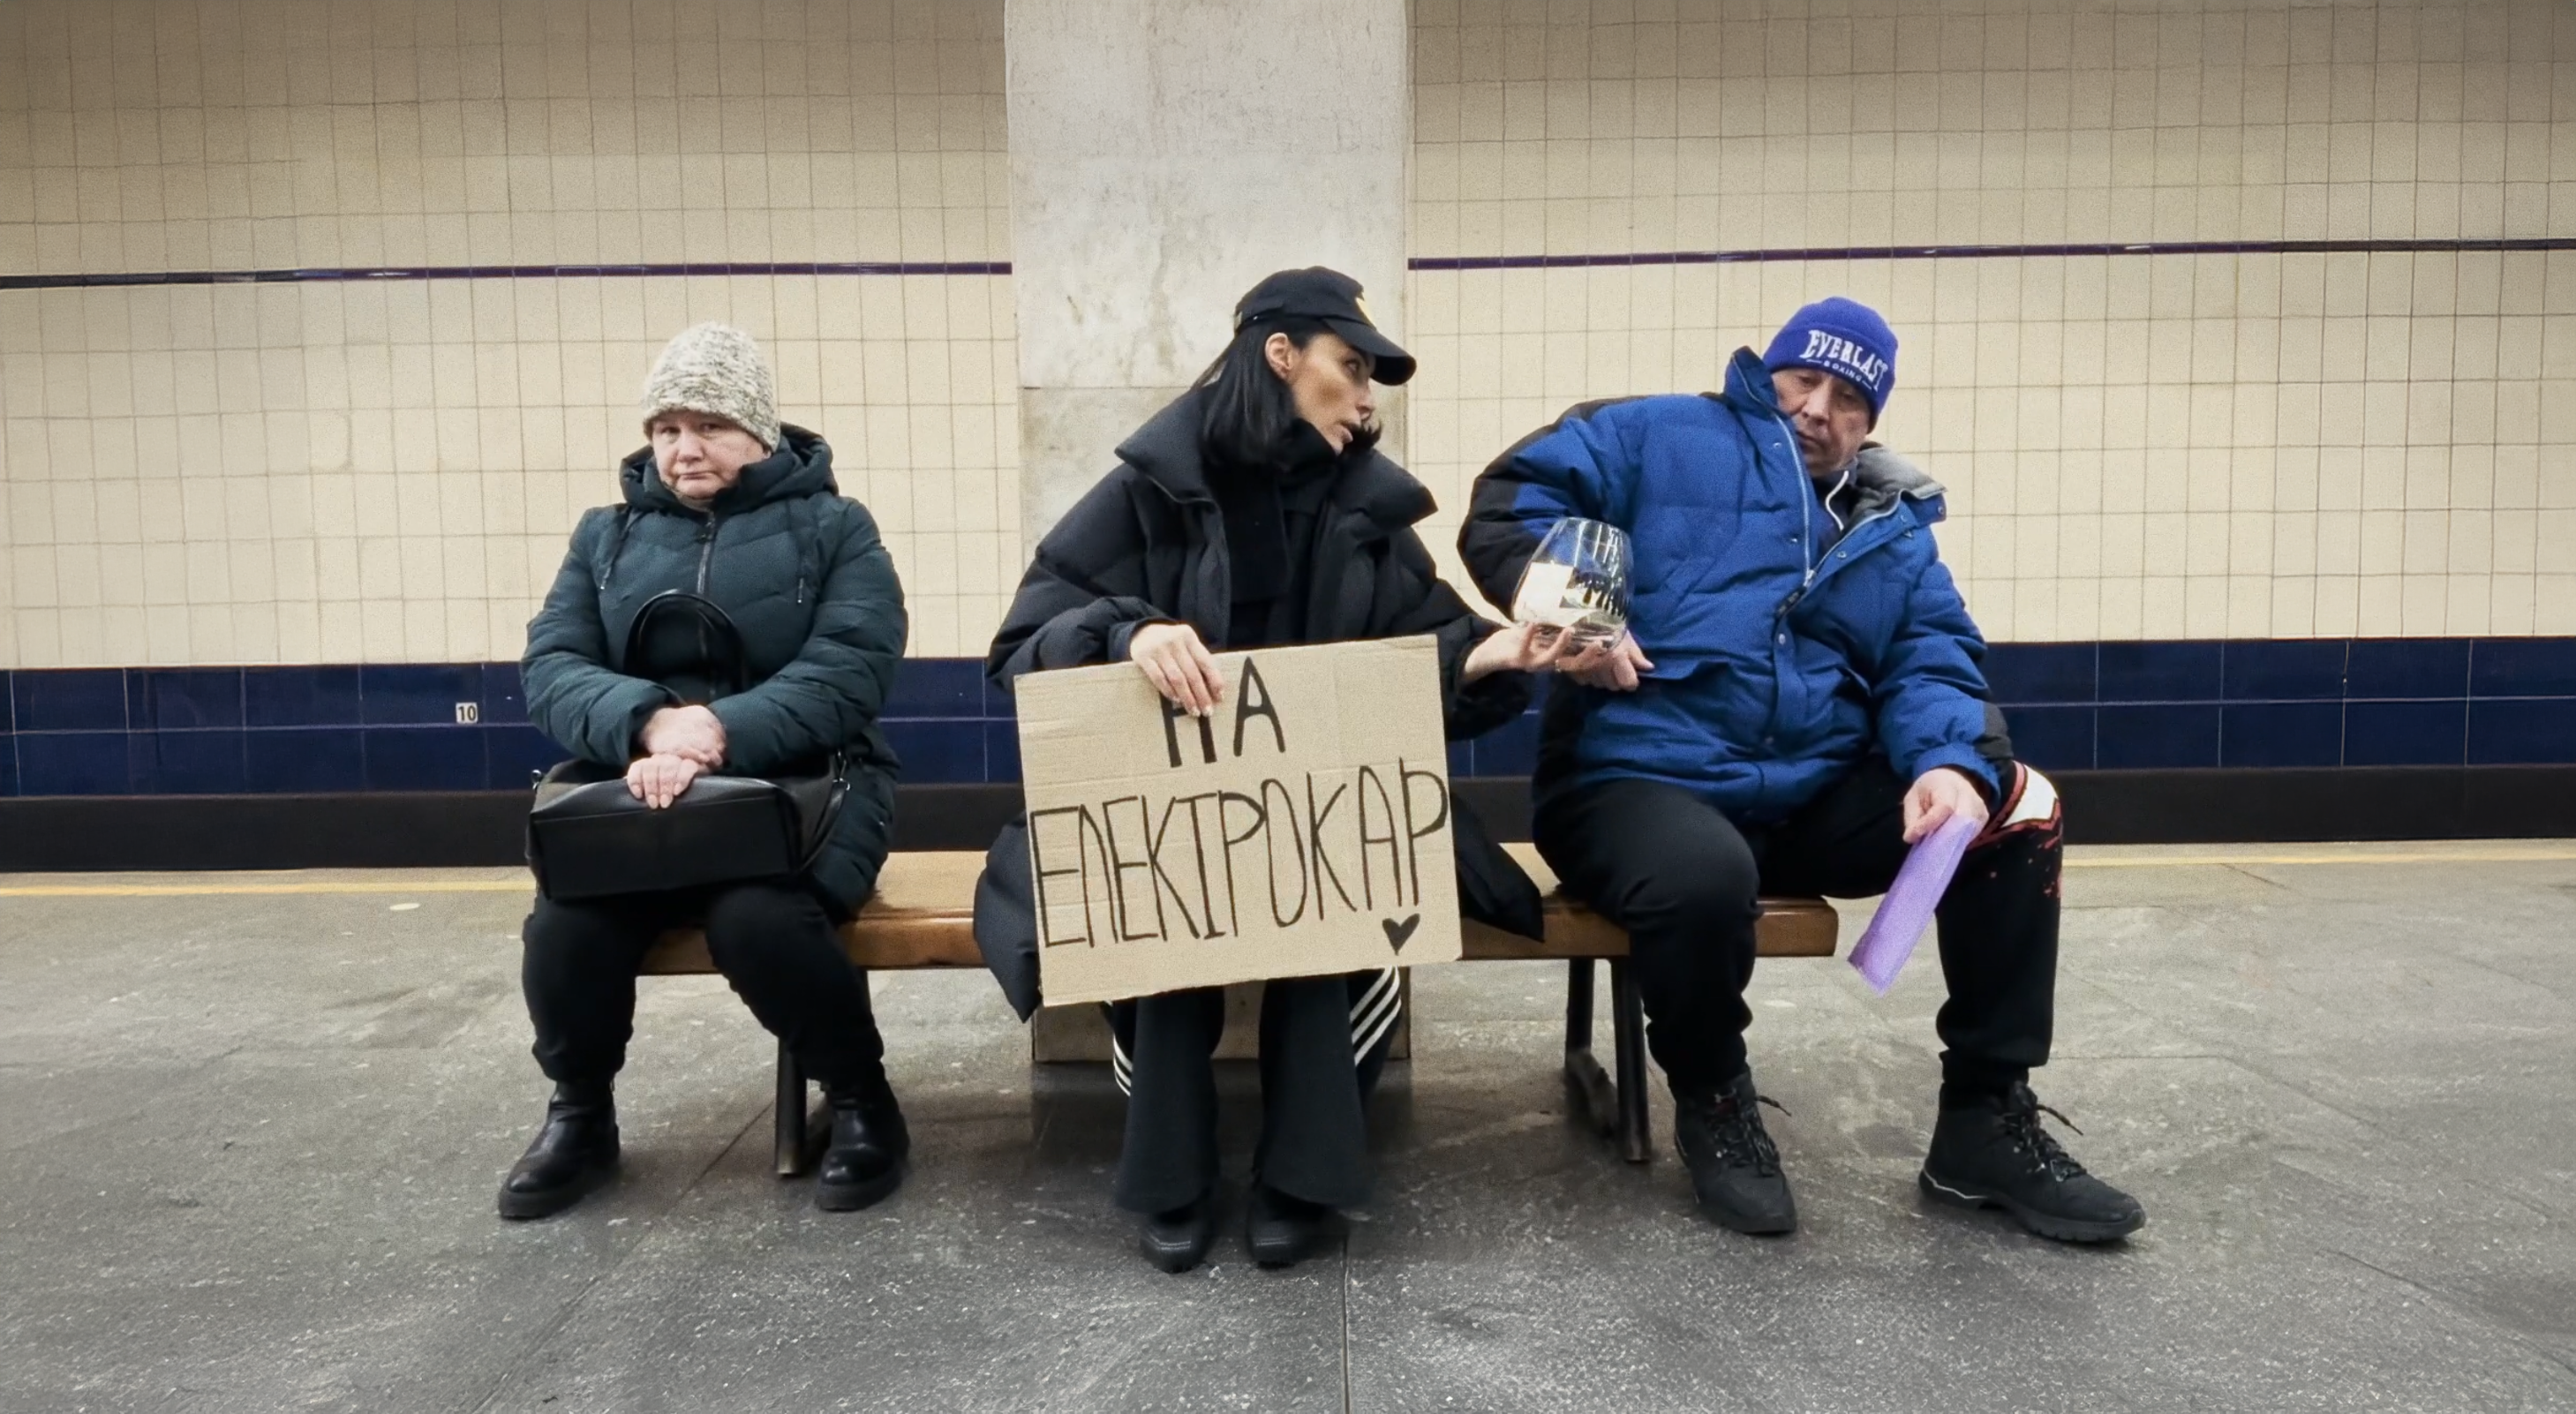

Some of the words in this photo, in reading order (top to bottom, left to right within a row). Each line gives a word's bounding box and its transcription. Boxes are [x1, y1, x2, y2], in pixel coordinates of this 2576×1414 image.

[1799, 329, 1888, 391] EVERLAST
[1824, 360, 1862, 381] BOXING
[458, 705, 477, 721] 10
[1160, 657, 1285, 767] НА
[1030, 757, 1449, 948] ЕЛЕКТРОКАР
